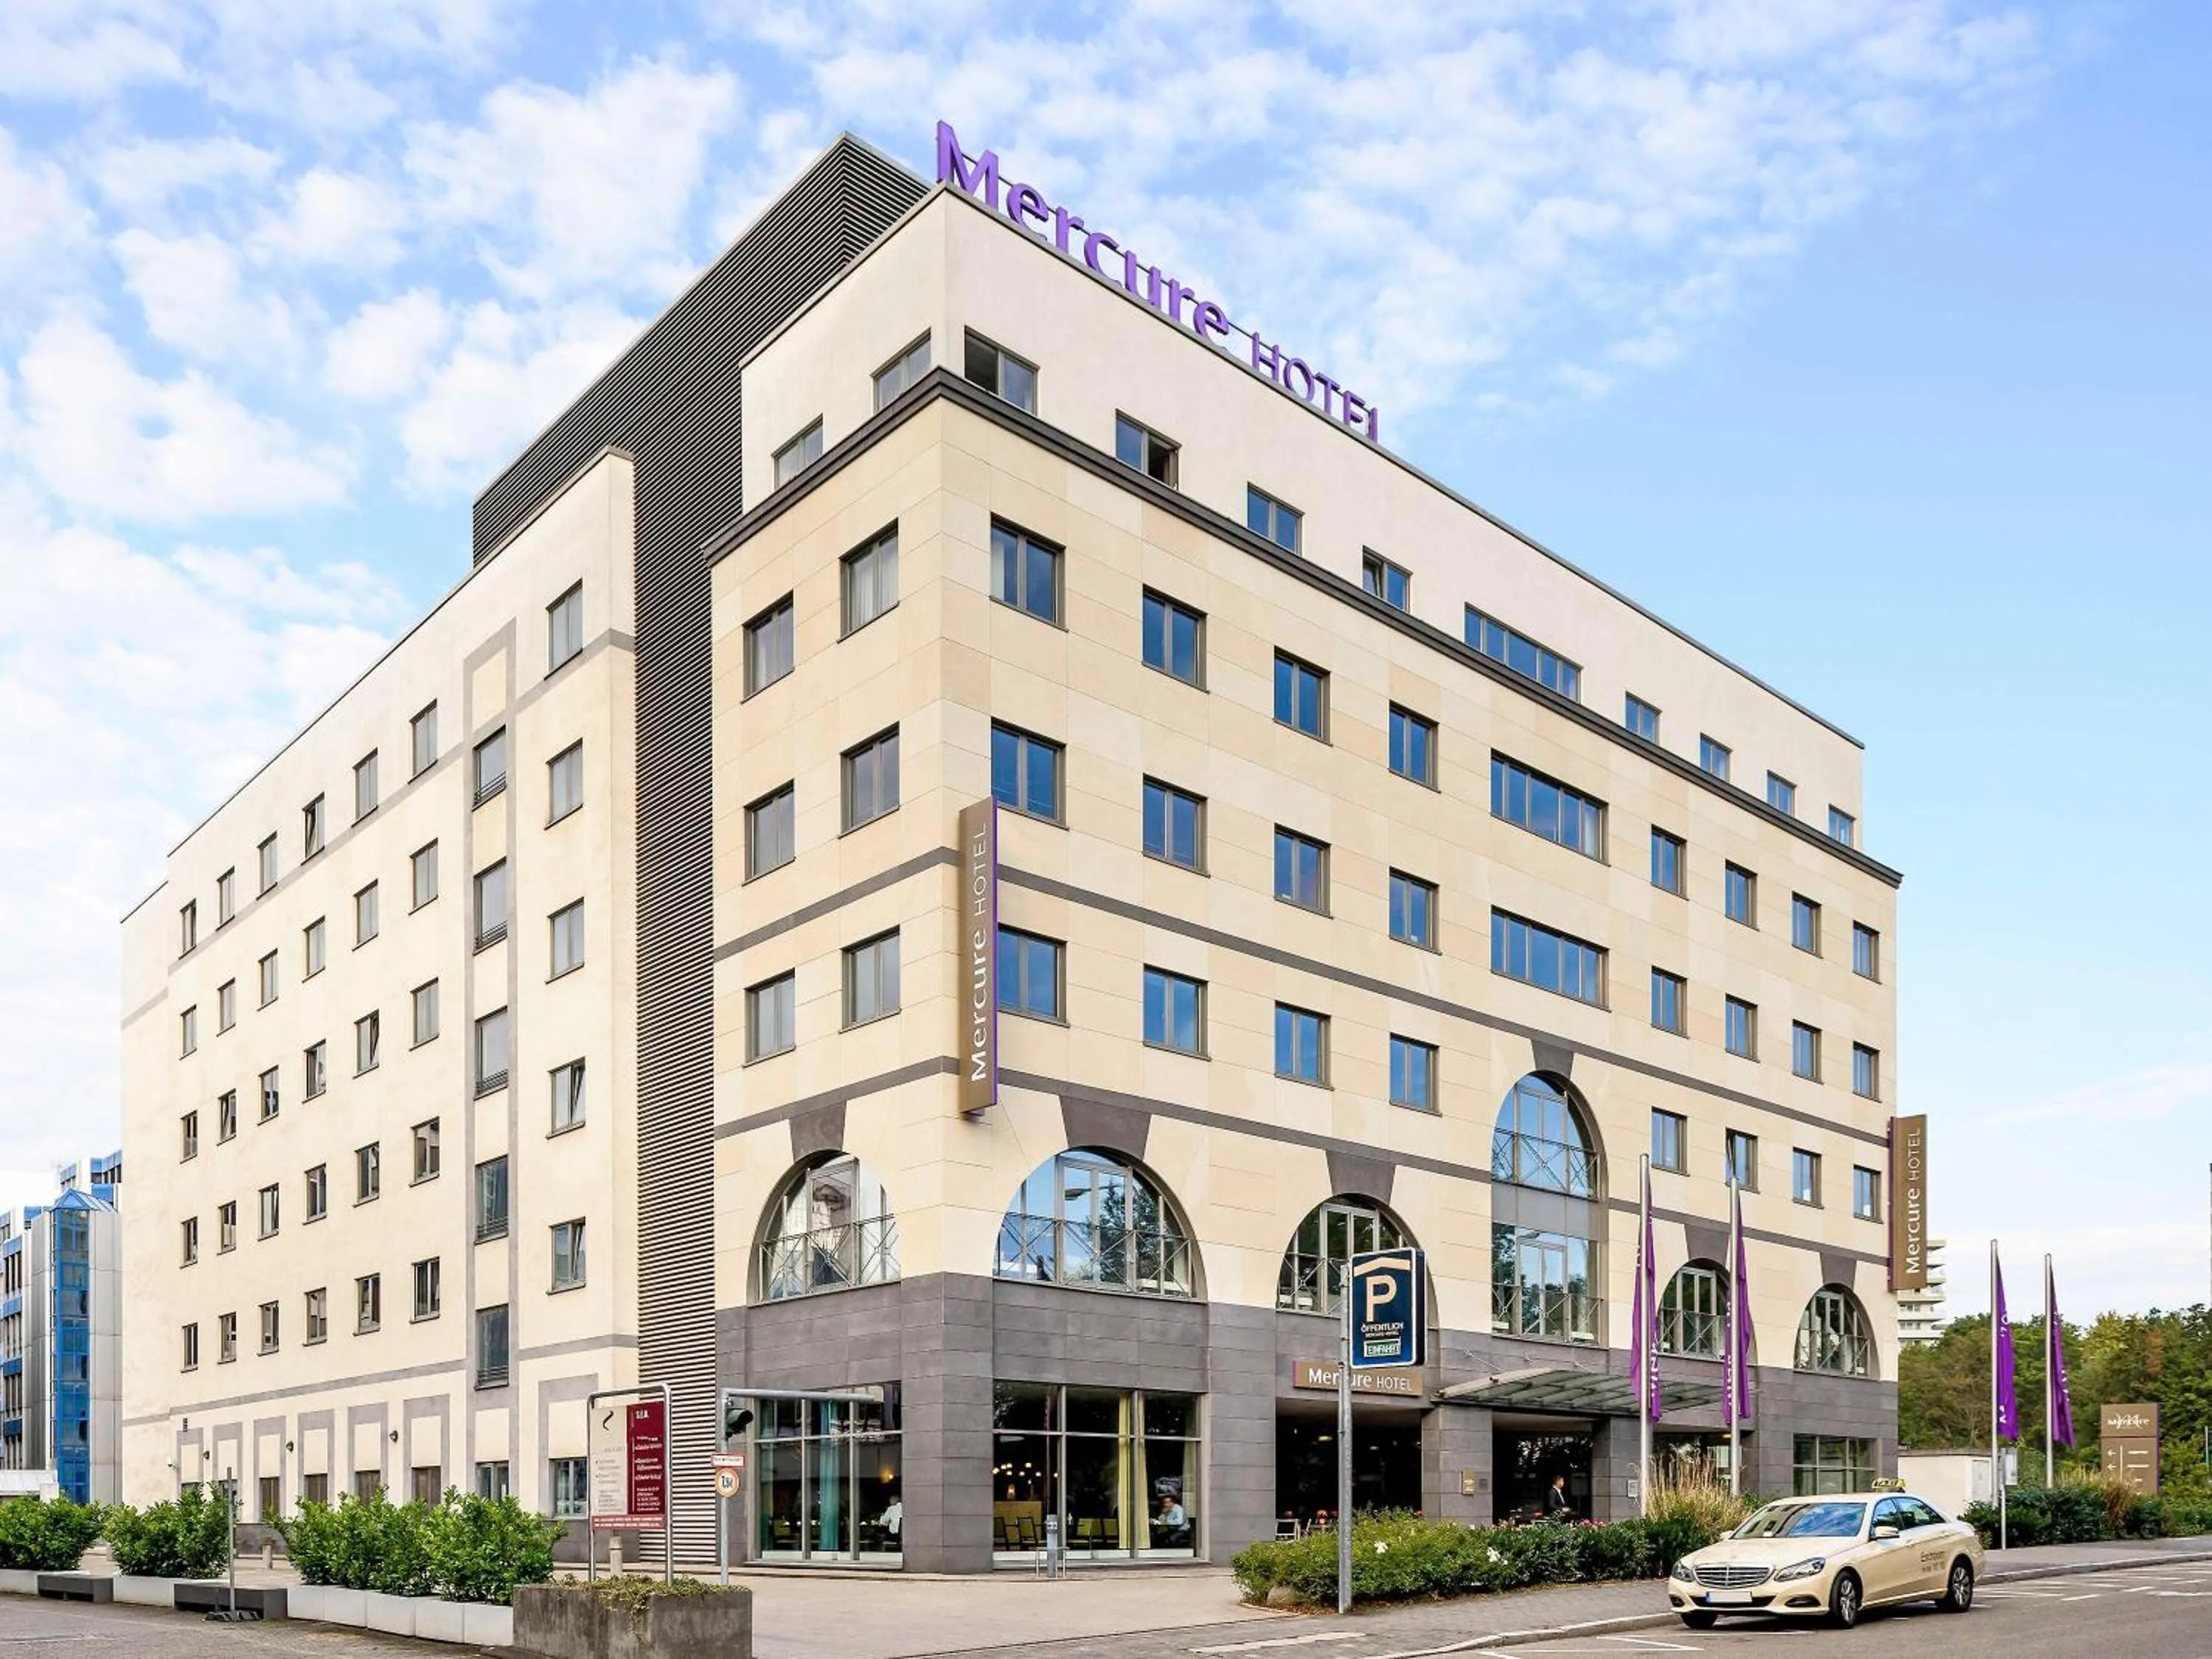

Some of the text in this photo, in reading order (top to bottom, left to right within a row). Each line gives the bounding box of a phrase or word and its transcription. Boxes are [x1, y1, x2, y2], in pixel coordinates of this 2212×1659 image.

[936, 119, 1230, 351] Mercure
[971, 821, 987, 1082] Mercure HOTEL
[1906, 1126, 1921, 1275] Mercure HOTEL
[1360, 1321, 1404, 1332] ÖFFENTLICH
[1366, 1274, 1397, 1322] P
[1308, 1368, 1413, 1391] Merure HOTEL
